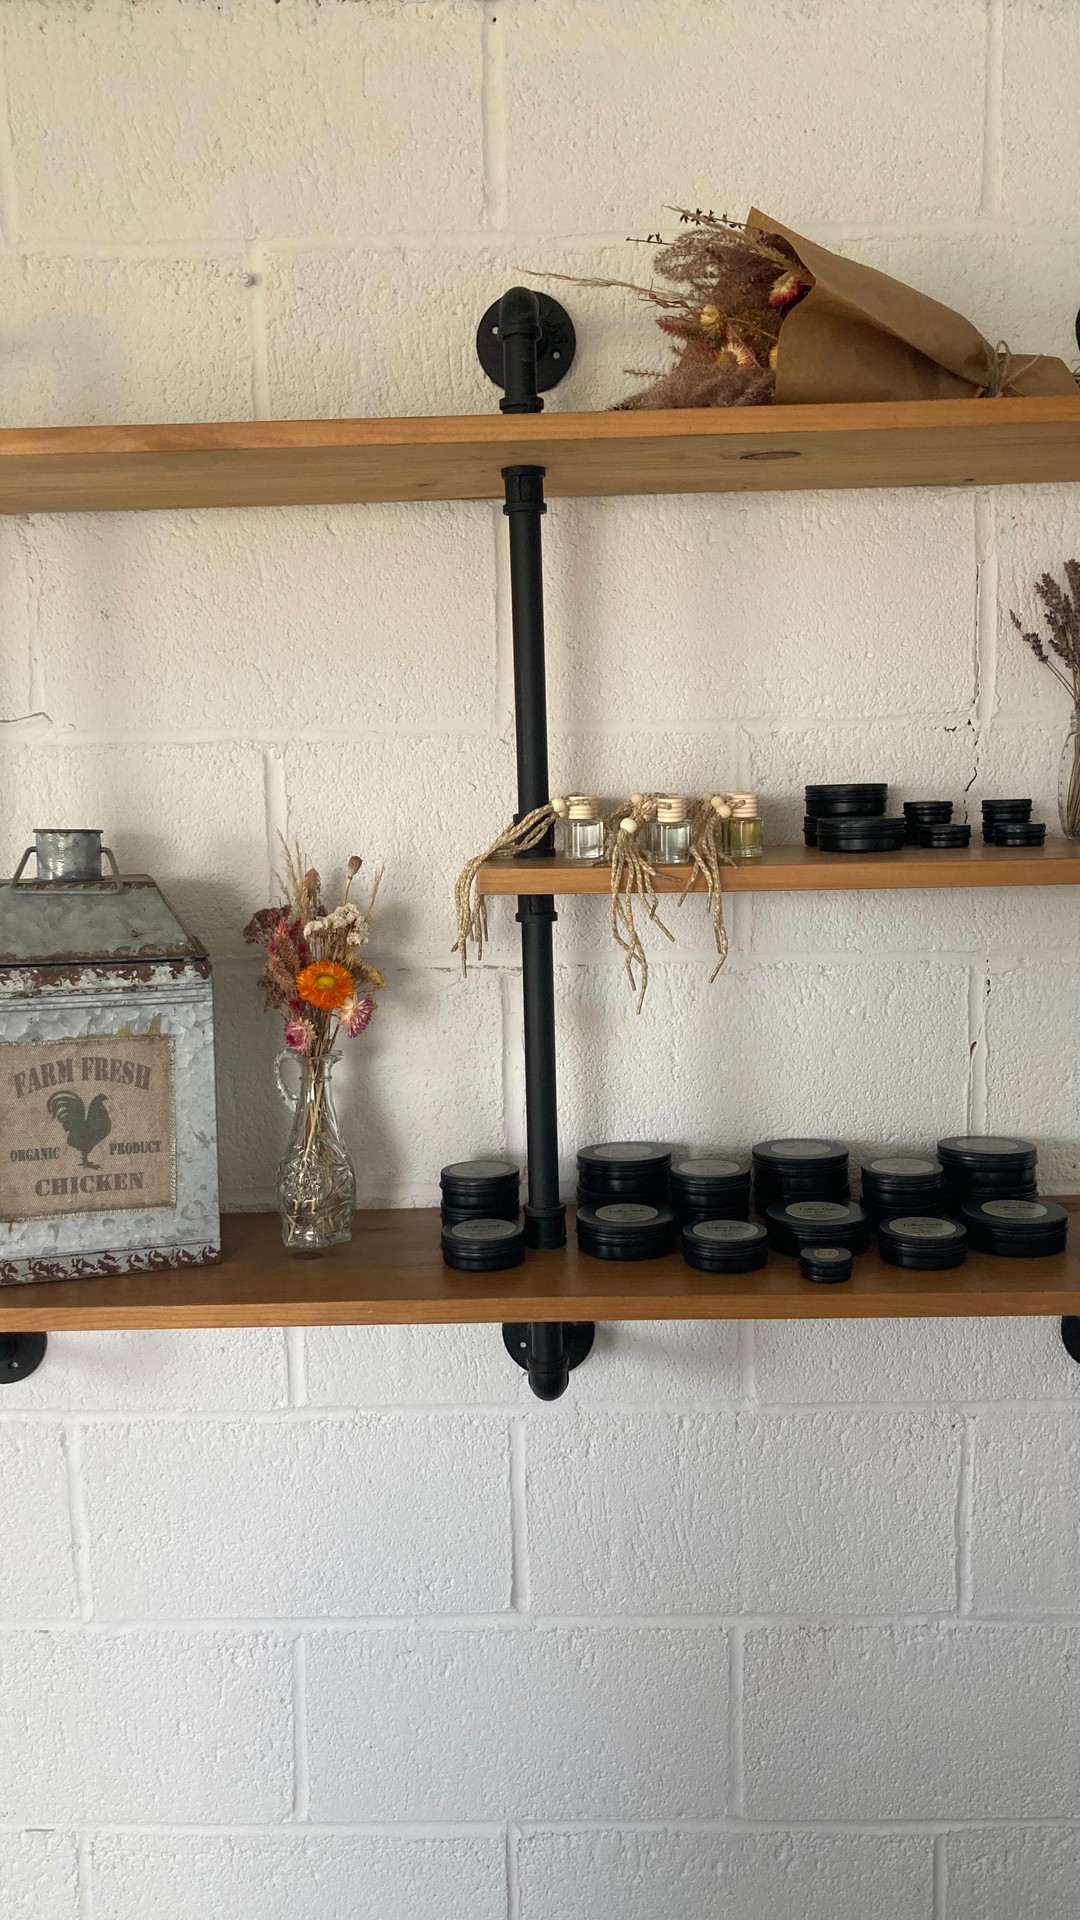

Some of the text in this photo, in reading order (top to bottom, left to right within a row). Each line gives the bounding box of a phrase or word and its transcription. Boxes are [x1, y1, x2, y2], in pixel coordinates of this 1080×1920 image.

[13, 1056, 152, 1098] FARM FRESH
[10, 1140, 162, 1162] ORGANIC PRODUCT
[35, 1172, 144, 1197] CHICKEN
